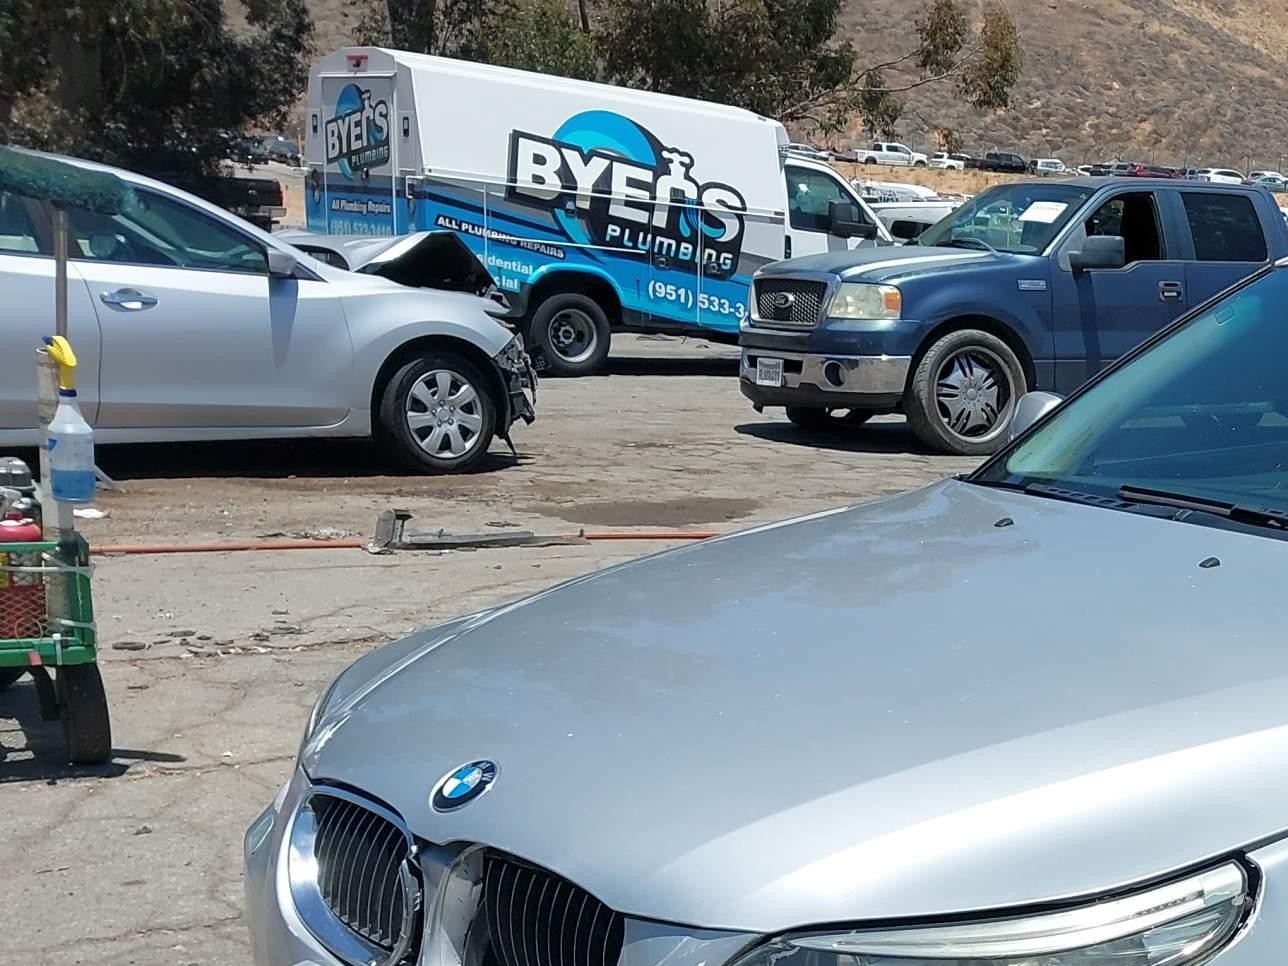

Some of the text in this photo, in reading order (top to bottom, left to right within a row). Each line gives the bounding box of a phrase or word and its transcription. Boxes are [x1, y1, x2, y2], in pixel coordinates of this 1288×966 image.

[368, 200, 390, 214] Repairs
[437, 216, 564, 259] ALL PLUMBING REPAIRS
[605, 224, 734, 270] PLUMBING
[477, 253, 534, 275] sidential
[648, 280, 693, 309] (951)
[699, 293, 746, 319] 533-3
